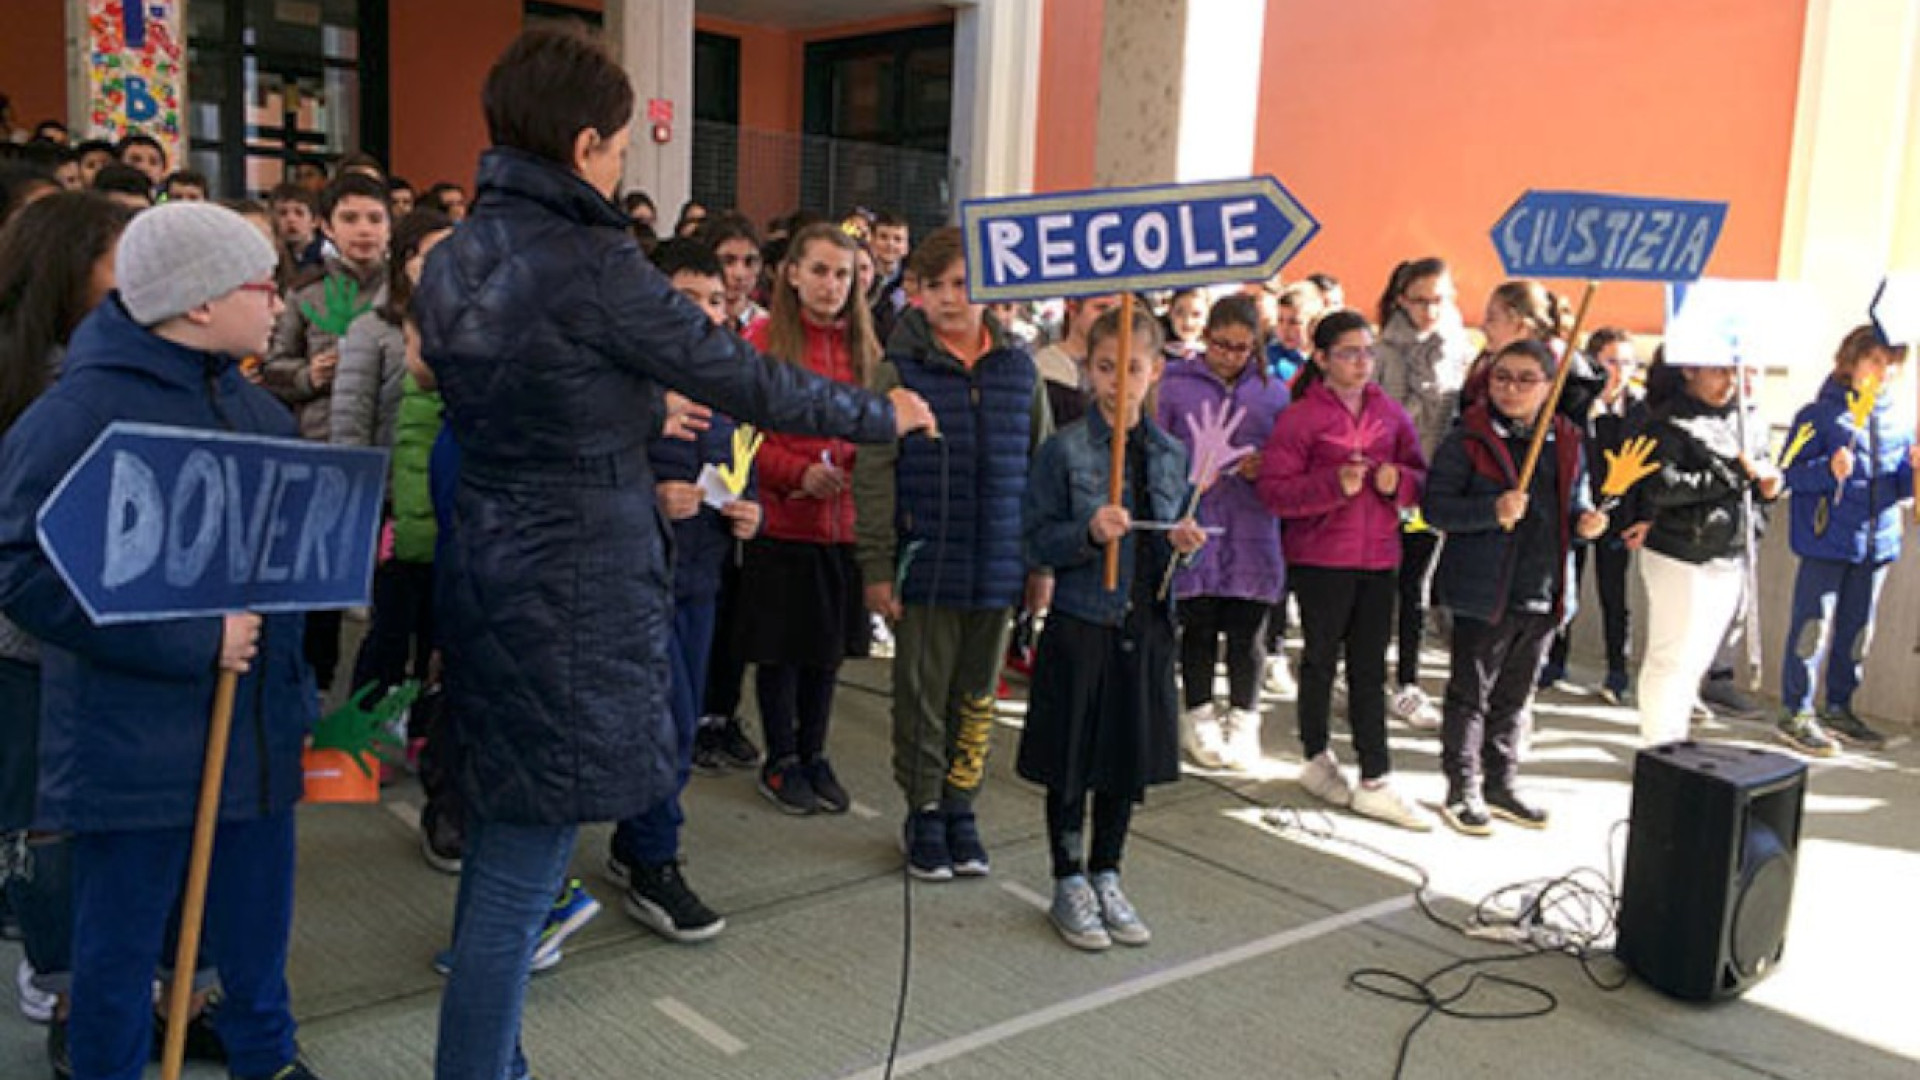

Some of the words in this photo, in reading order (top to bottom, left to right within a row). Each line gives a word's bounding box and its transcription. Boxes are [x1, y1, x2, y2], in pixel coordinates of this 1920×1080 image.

[125, 75, 158, 121] B
[987, 201, 1259, 284] REGOLE
[1502, 206, 1710, 274] GIUSTIZIA
[101, 449, 365, 588] DOVERI
